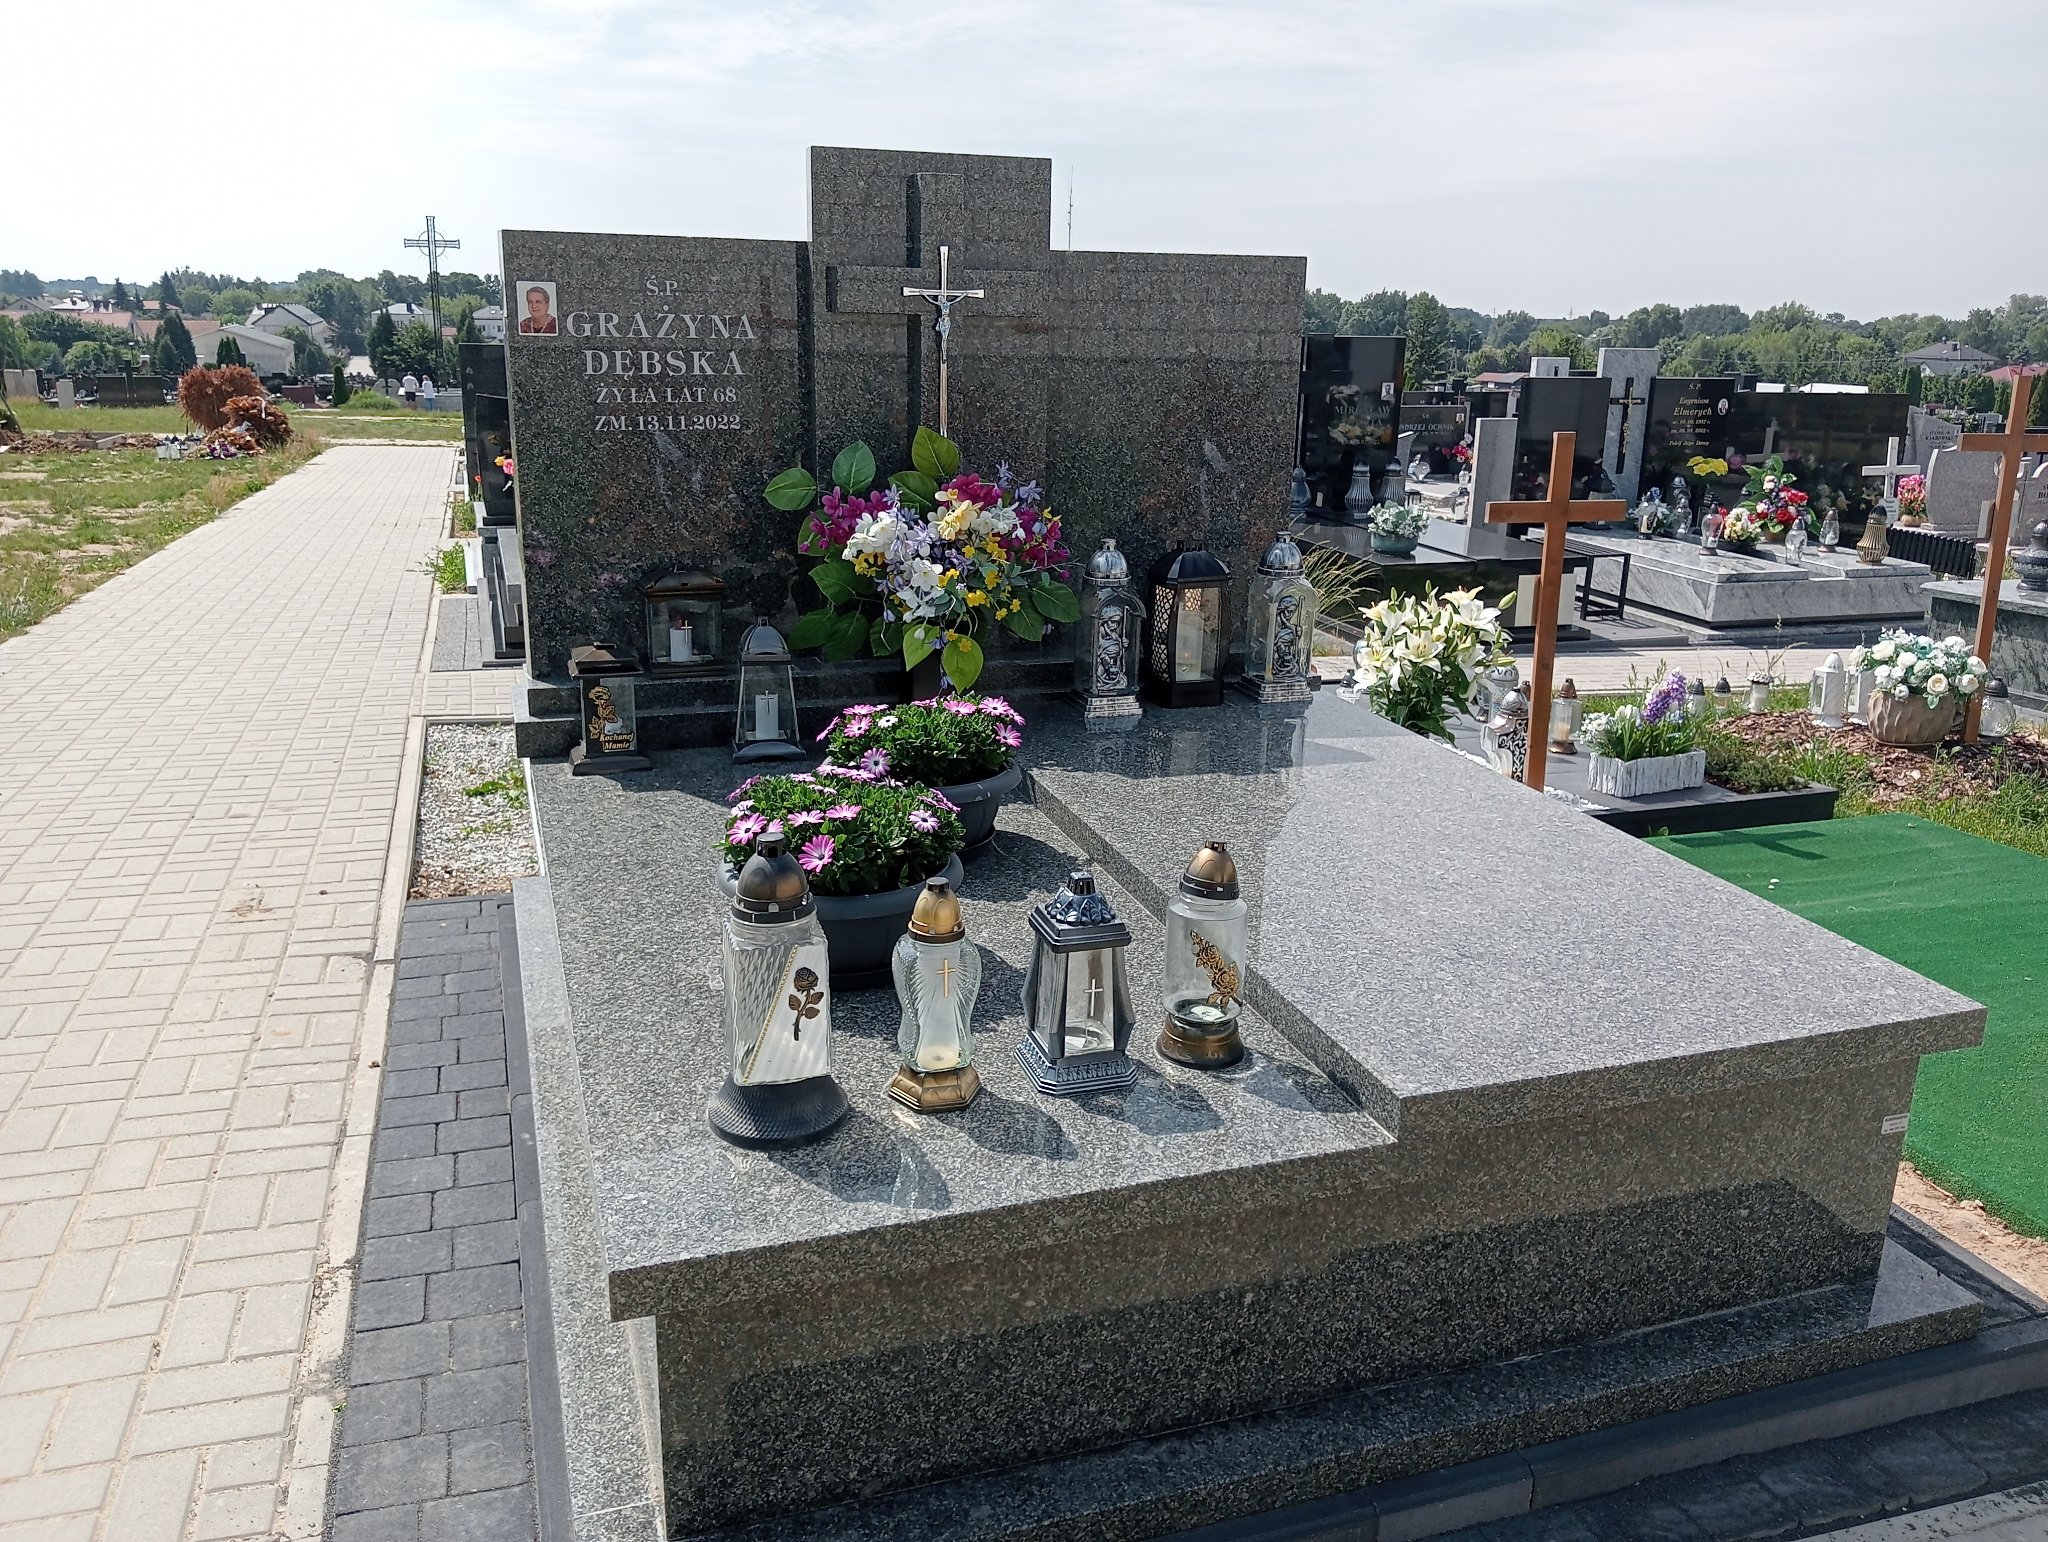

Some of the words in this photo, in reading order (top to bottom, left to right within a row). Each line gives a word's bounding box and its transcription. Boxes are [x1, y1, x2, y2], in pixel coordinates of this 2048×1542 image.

[566, 304, 757, 340] GRAŻYNA
[582, 349, 746, 381] DĘBSKA
[596, 383, 658, 403] ŻYŁA
[666, 387, 707, 403] LAT
[713, 386, 738, 403] 68
[600, 733, 634, 741] Kochanej
